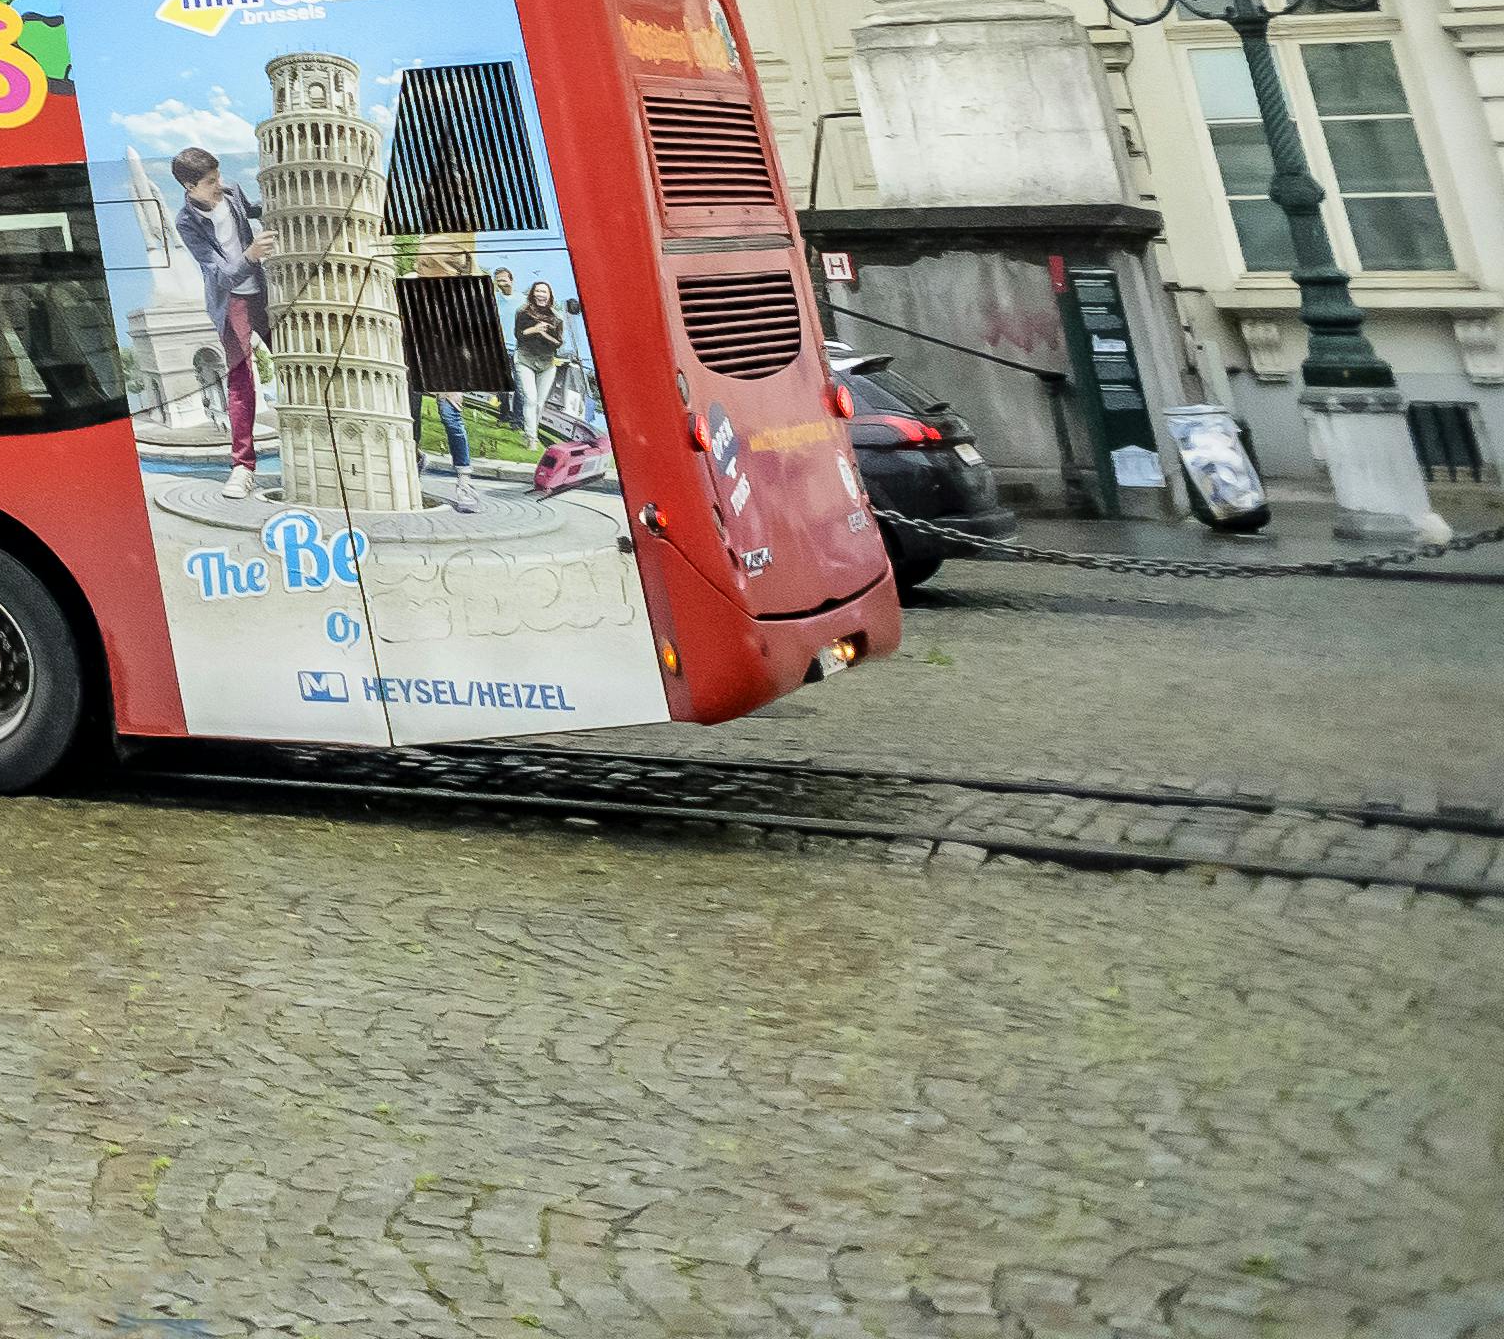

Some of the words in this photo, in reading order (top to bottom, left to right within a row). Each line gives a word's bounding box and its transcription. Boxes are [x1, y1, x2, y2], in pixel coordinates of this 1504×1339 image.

[828, 257, 846, 276] H
[186, 546, 268, 598] The
[361, 675, 576, 712] HEYSEL/HEIZEL
